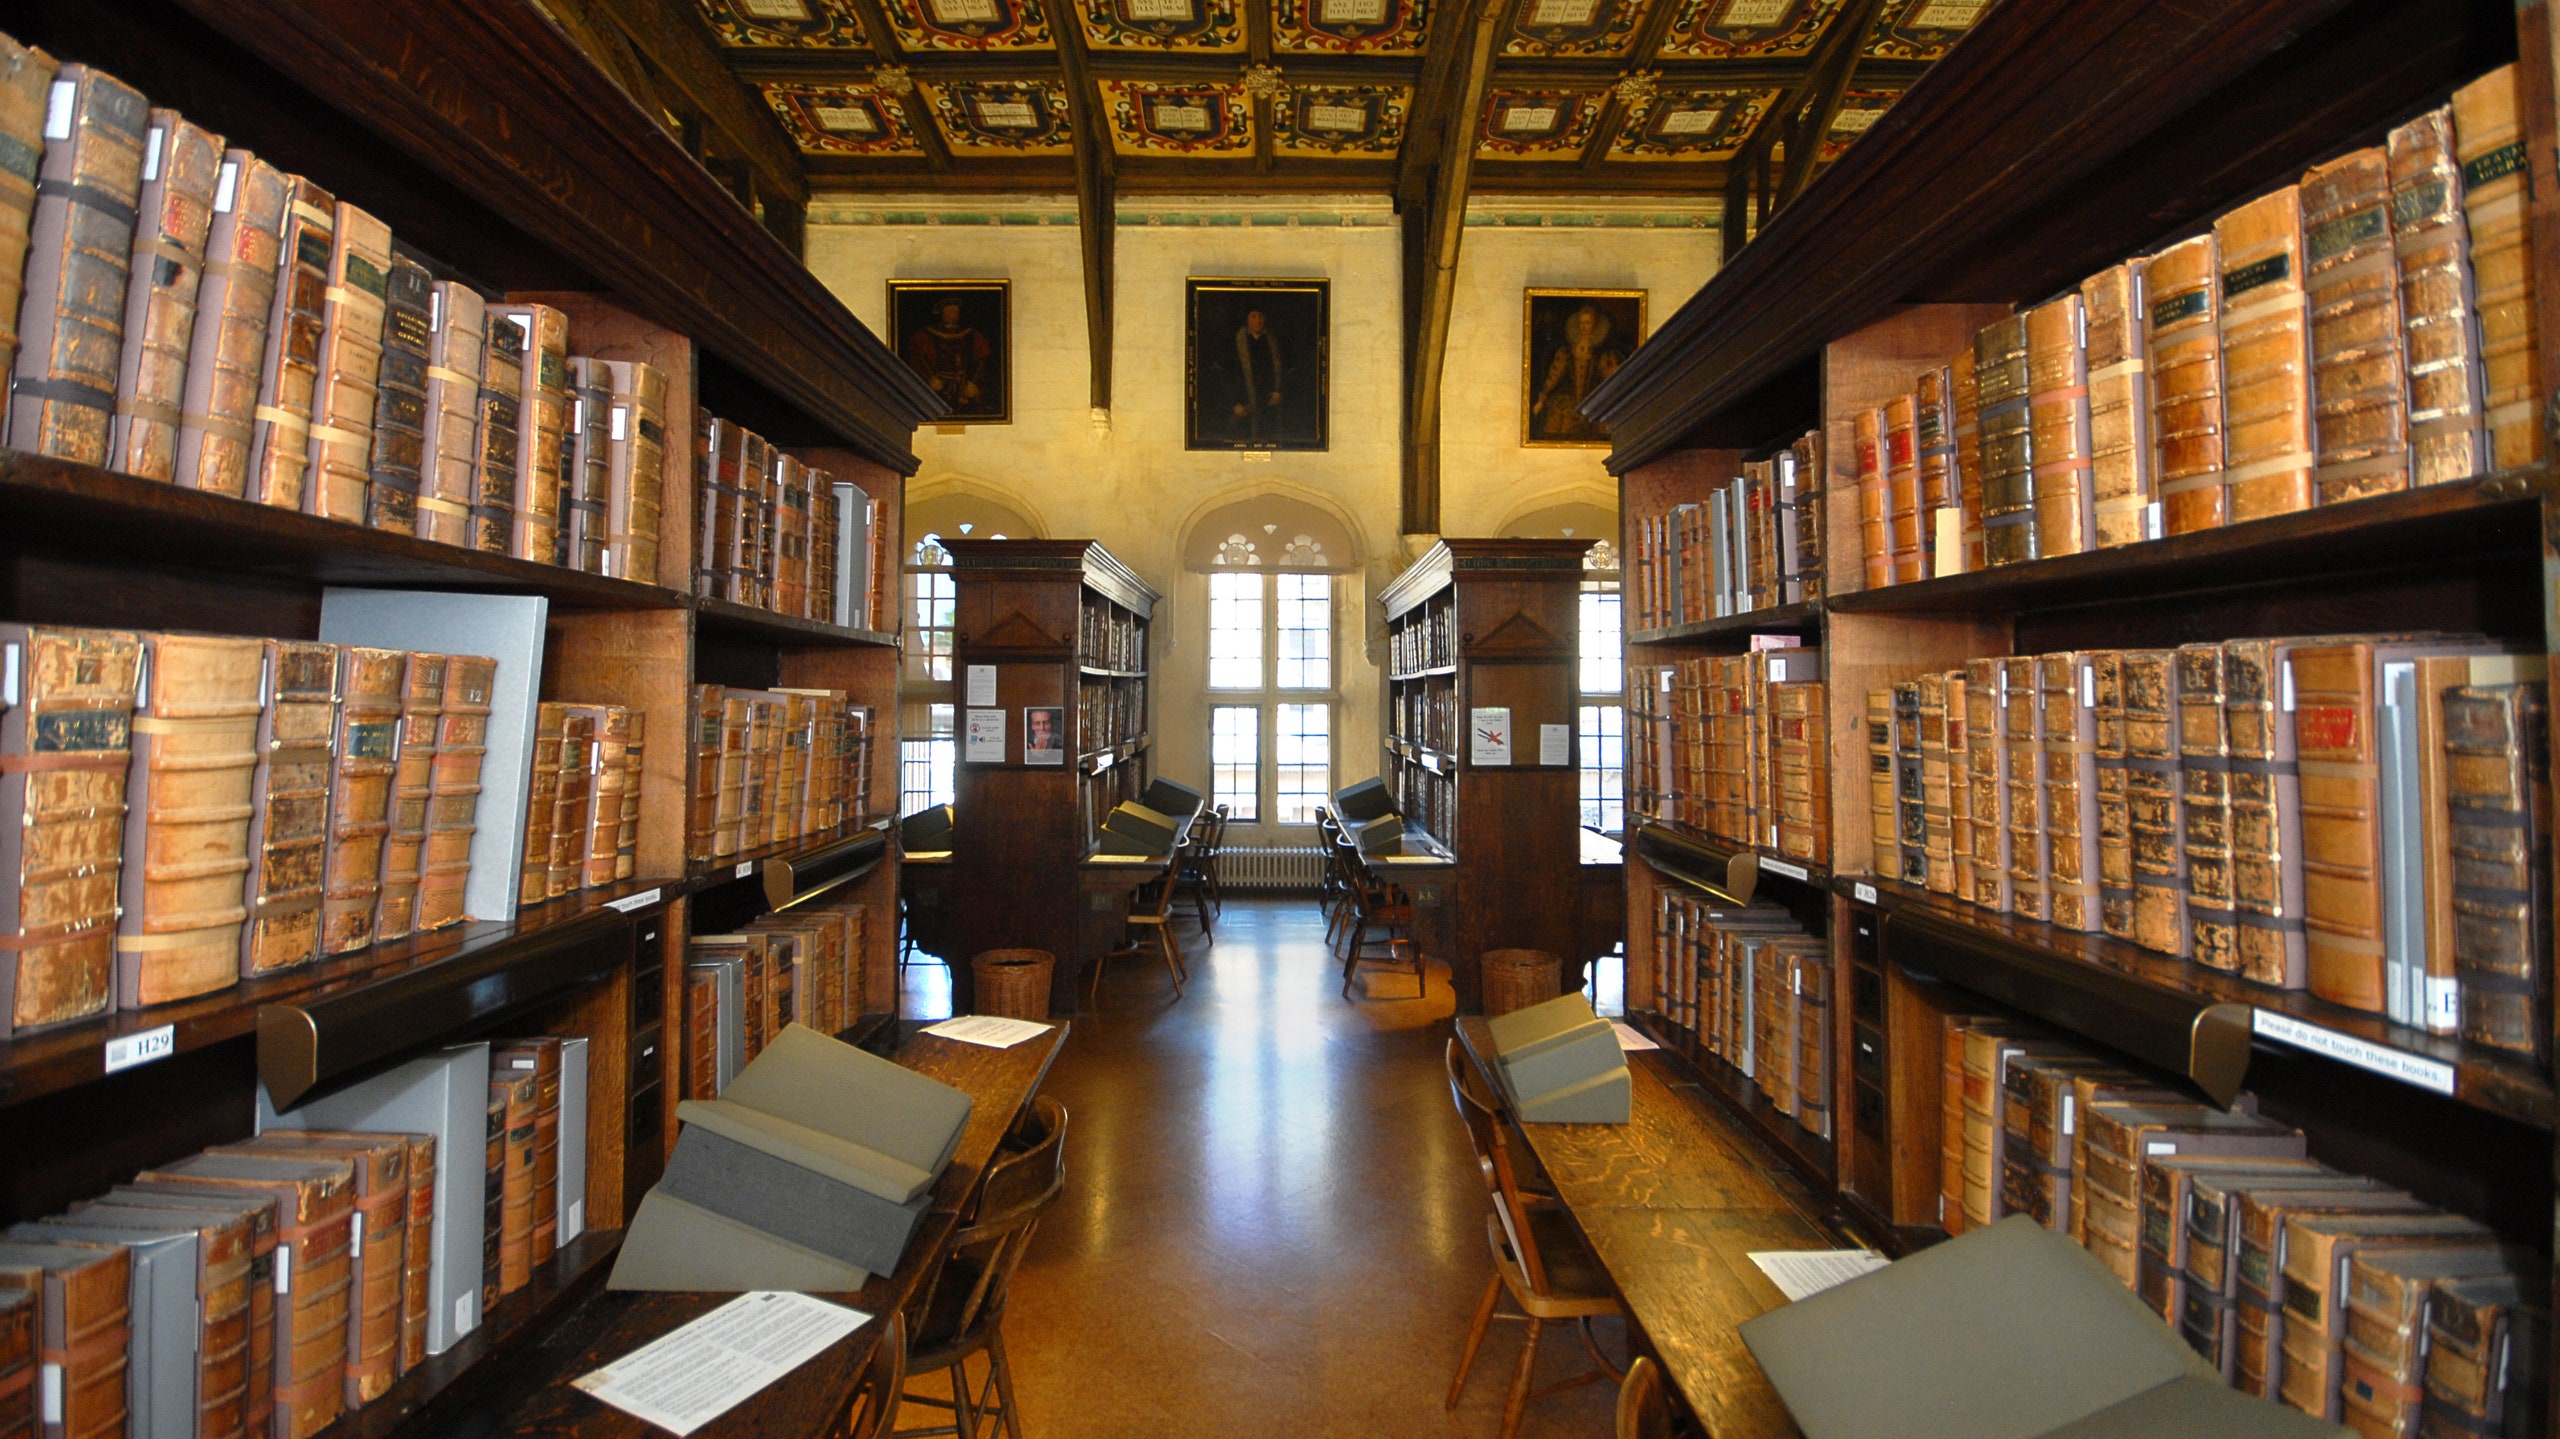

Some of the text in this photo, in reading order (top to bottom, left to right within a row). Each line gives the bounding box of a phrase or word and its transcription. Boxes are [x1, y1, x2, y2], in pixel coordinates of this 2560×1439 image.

[469, 689, 482, 702] 12
[138, 1033, 169, 1056] H29
[2261, 1017, 2441, 1082] Please do not touch these books.
